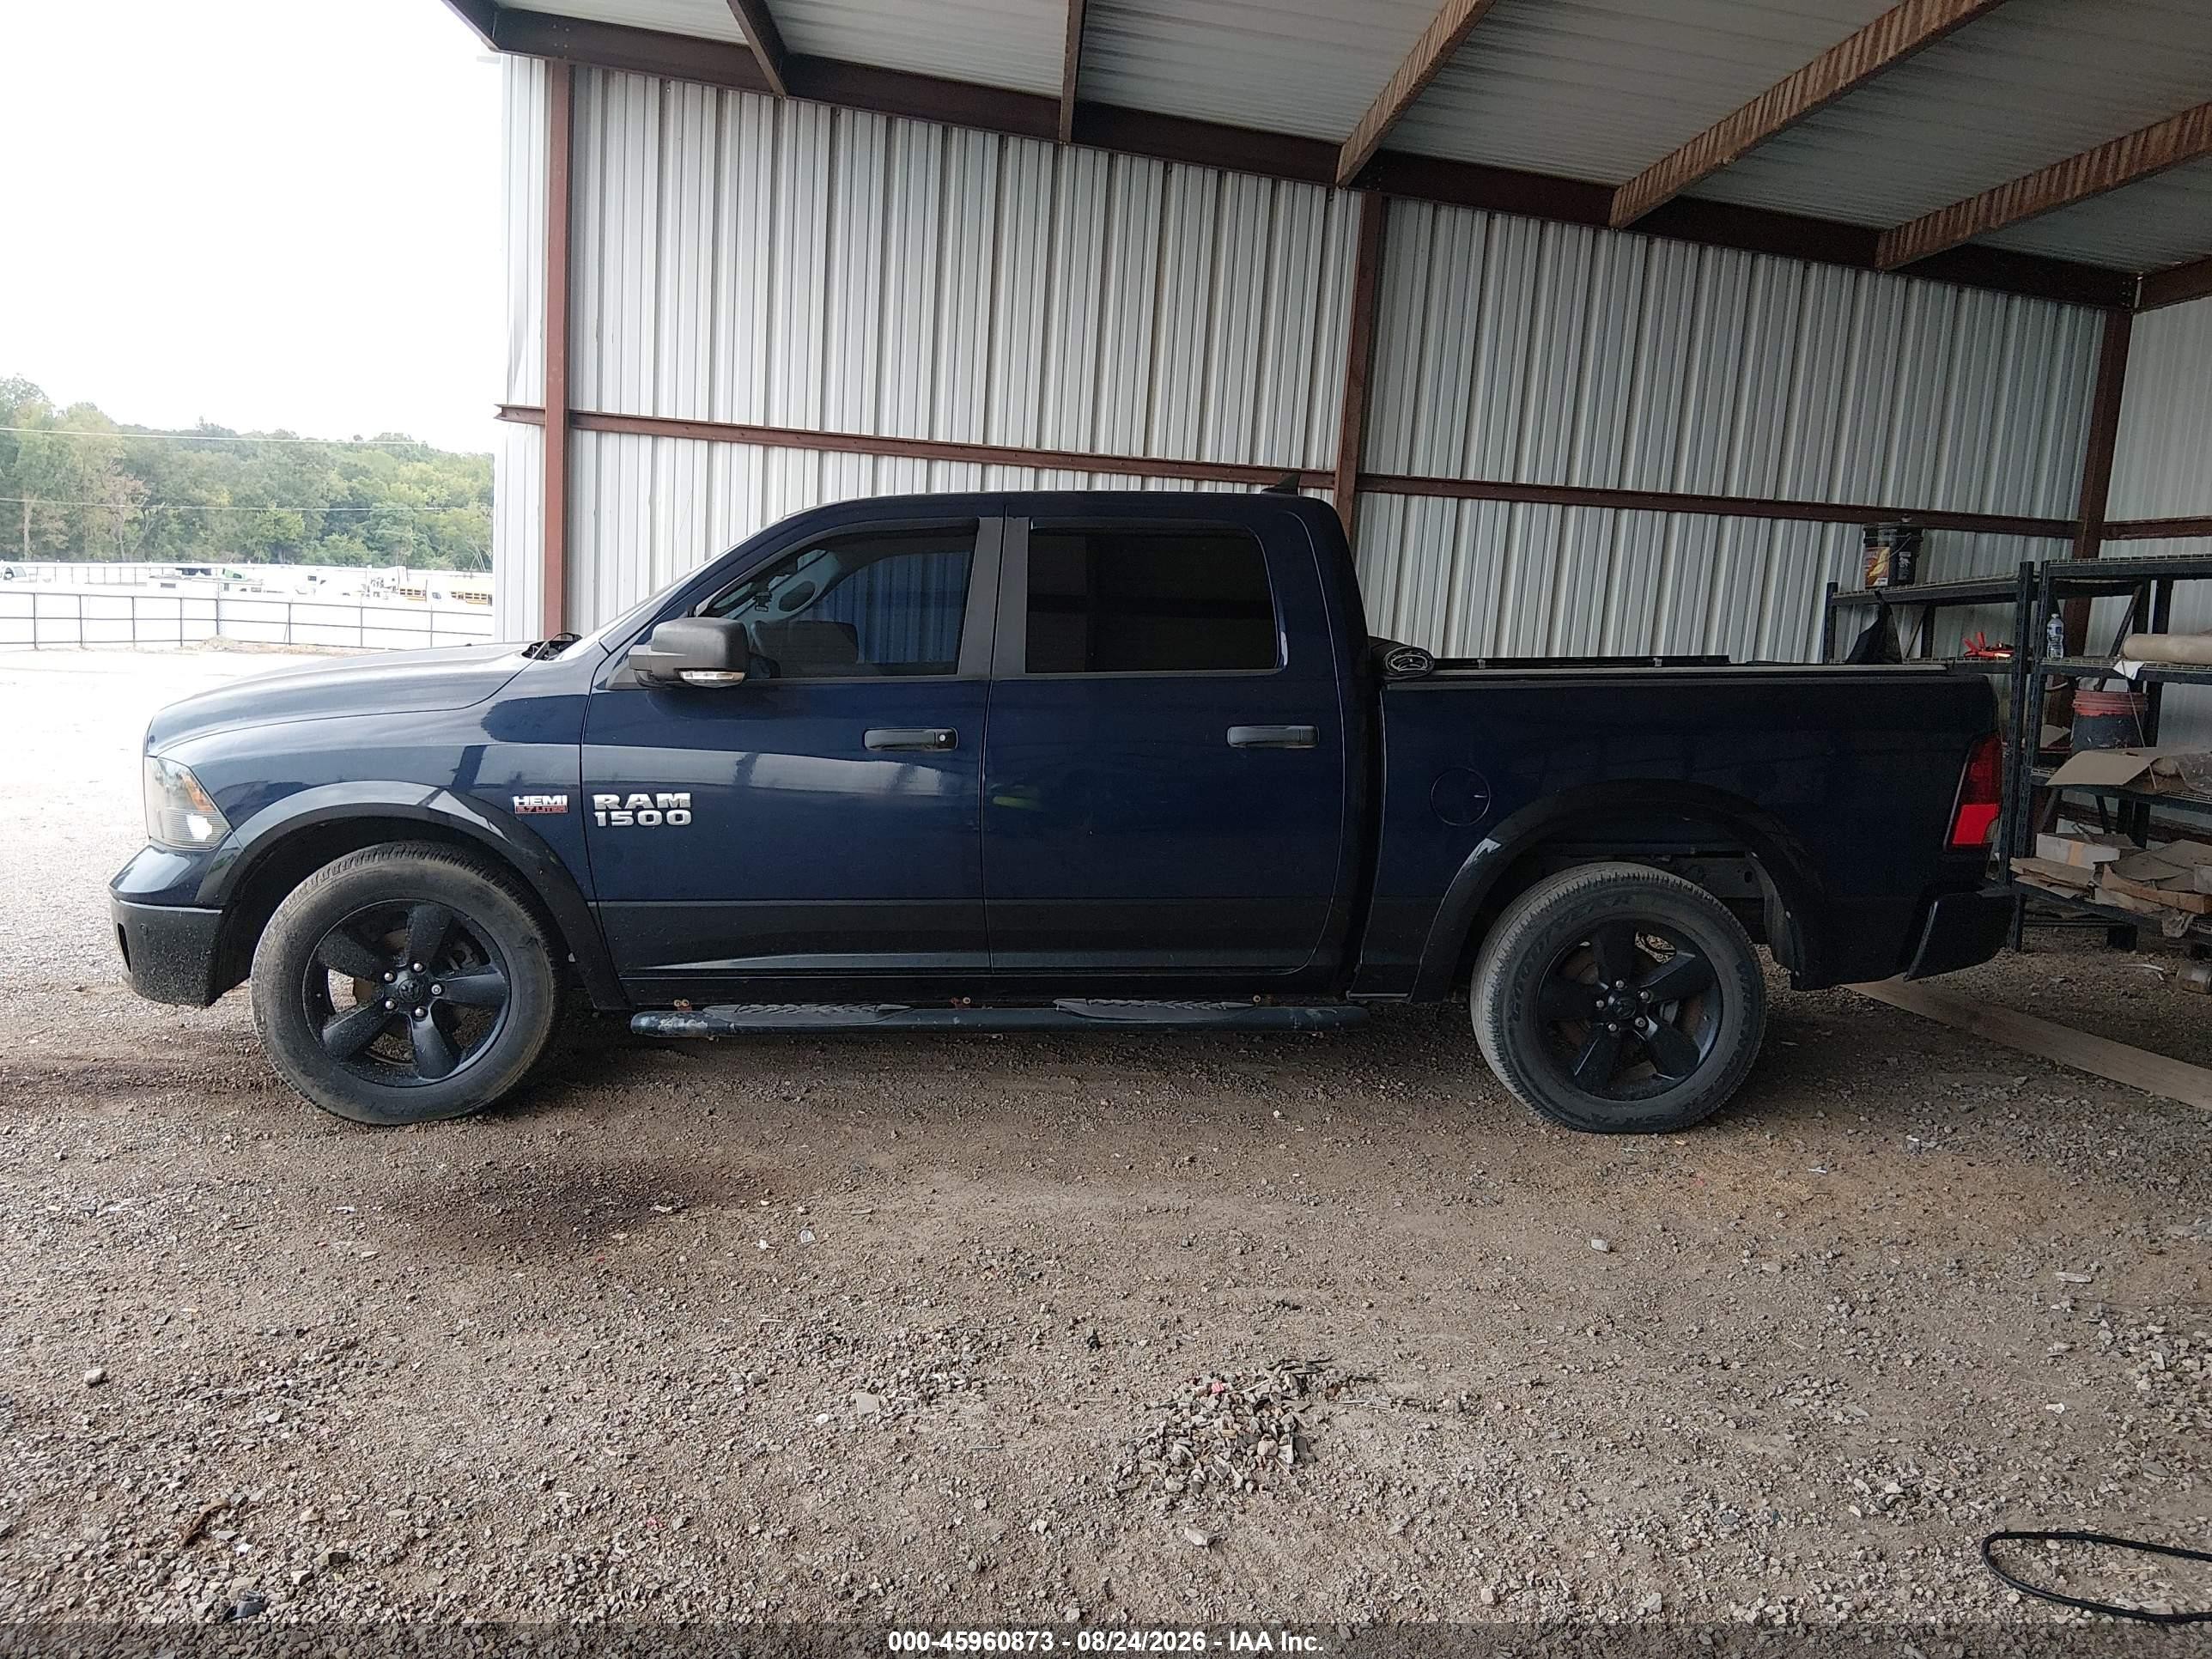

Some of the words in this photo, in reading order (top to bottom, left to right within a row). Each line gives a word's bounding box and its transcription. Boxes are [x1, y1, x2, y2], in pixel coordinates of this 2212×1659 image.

[513, 795, 568, 805] HEMI
[592, 793, 691, 809] RAM
[594, 810, 691, 827] 1500
